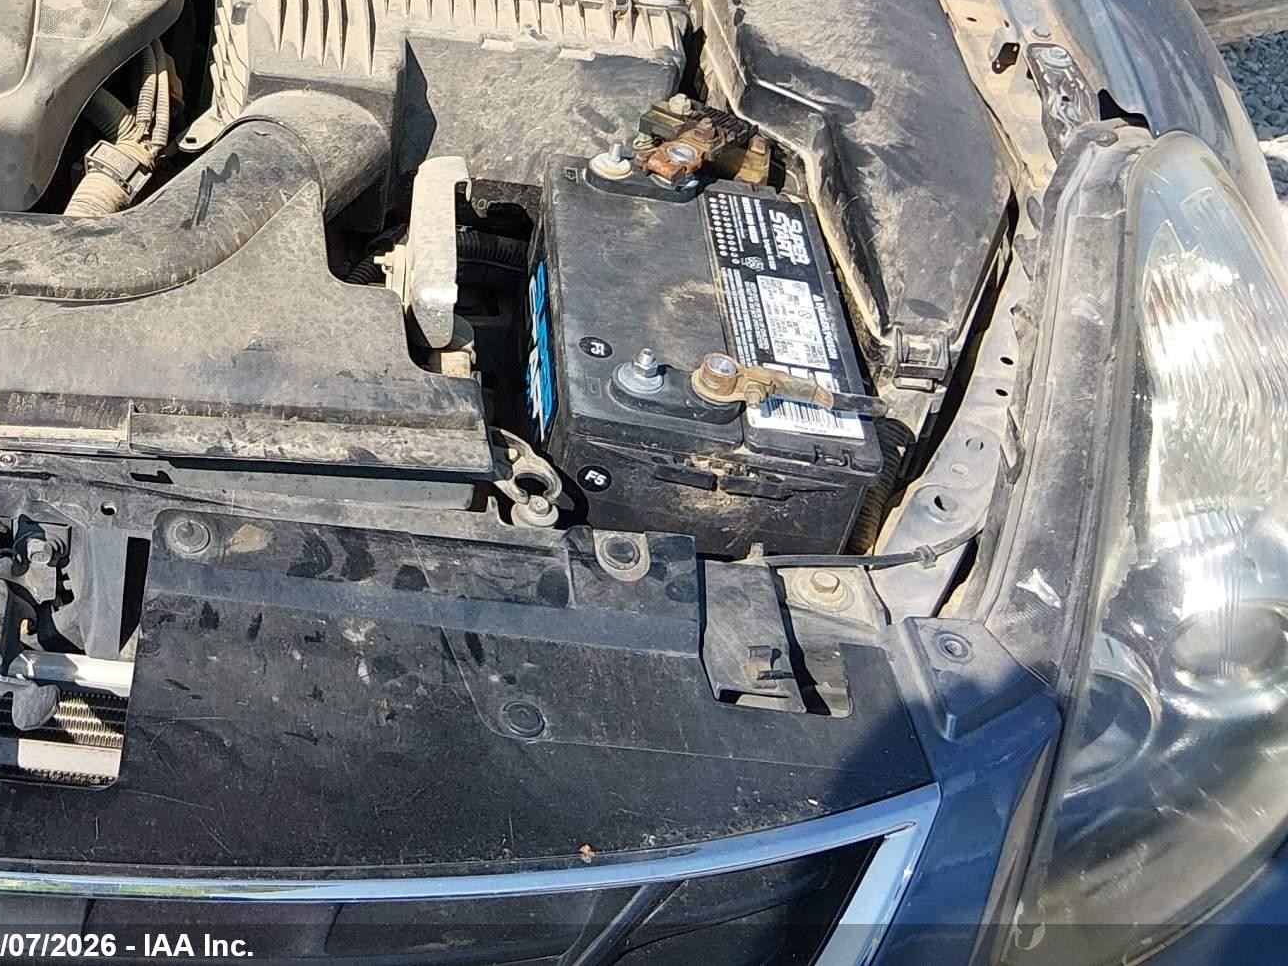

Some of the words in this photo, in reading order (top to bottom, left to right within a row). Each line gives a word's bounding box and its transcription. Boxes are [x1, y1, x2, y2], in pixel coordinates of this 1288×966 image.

[769, 209, 798, 265] START
[788, 219, 810, 265] SUPER
[585, 470, 607, 486] F5
